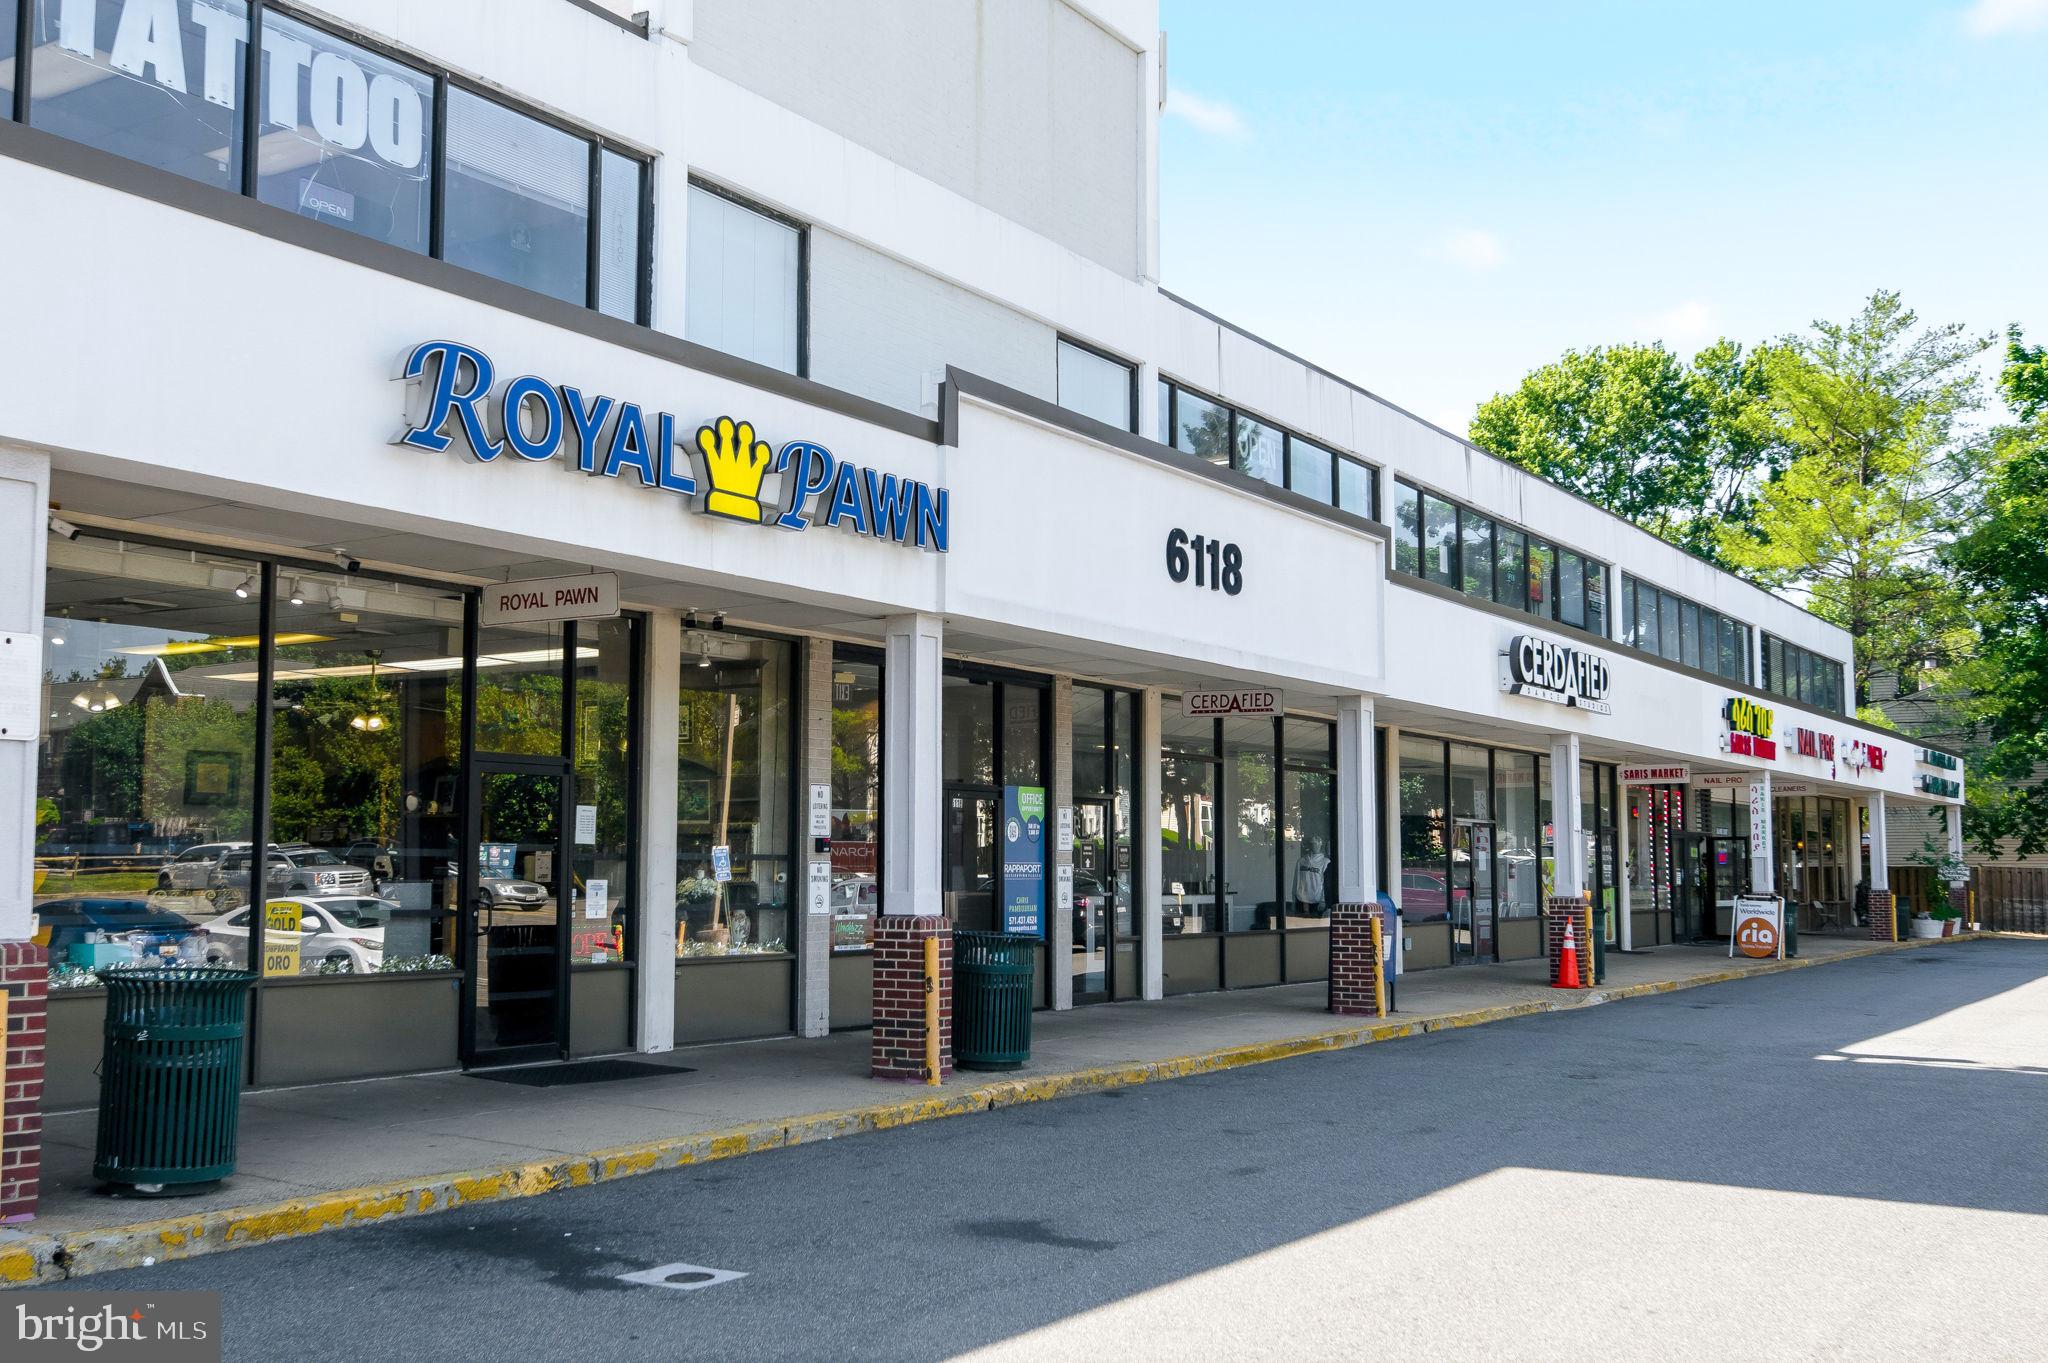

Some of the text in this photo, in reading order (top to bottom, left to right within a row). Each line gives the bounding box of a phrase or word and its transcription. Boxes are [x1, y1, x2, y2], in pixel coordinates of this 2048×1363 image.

[309, 197, 347, 217] OPEN
[402, 339, 951, 553] ROYAL PAWN
[1165, 527, 1243, 597] 6118
[500, 586, 599, 611] ROYAL PAWN
[1518, 634, 1611, 706] CERDAFIED
[1191, 692, 1274, 713] CERDAFIED
[1623, 767, 1684, 780] SARIS MARKET
[1771, 785, 1807, 793] CLEANERS
[1021, 792, 1043, 805] OFFICE
[830, 847, 875, 857] NARCH
[1004, 864, 1041, 873] RAPPAPORT
[1739, 907, 1776, 916] Worldwide
[1741, 922, 1773, 944] ria
[267, 955, 290, 971] ORO
